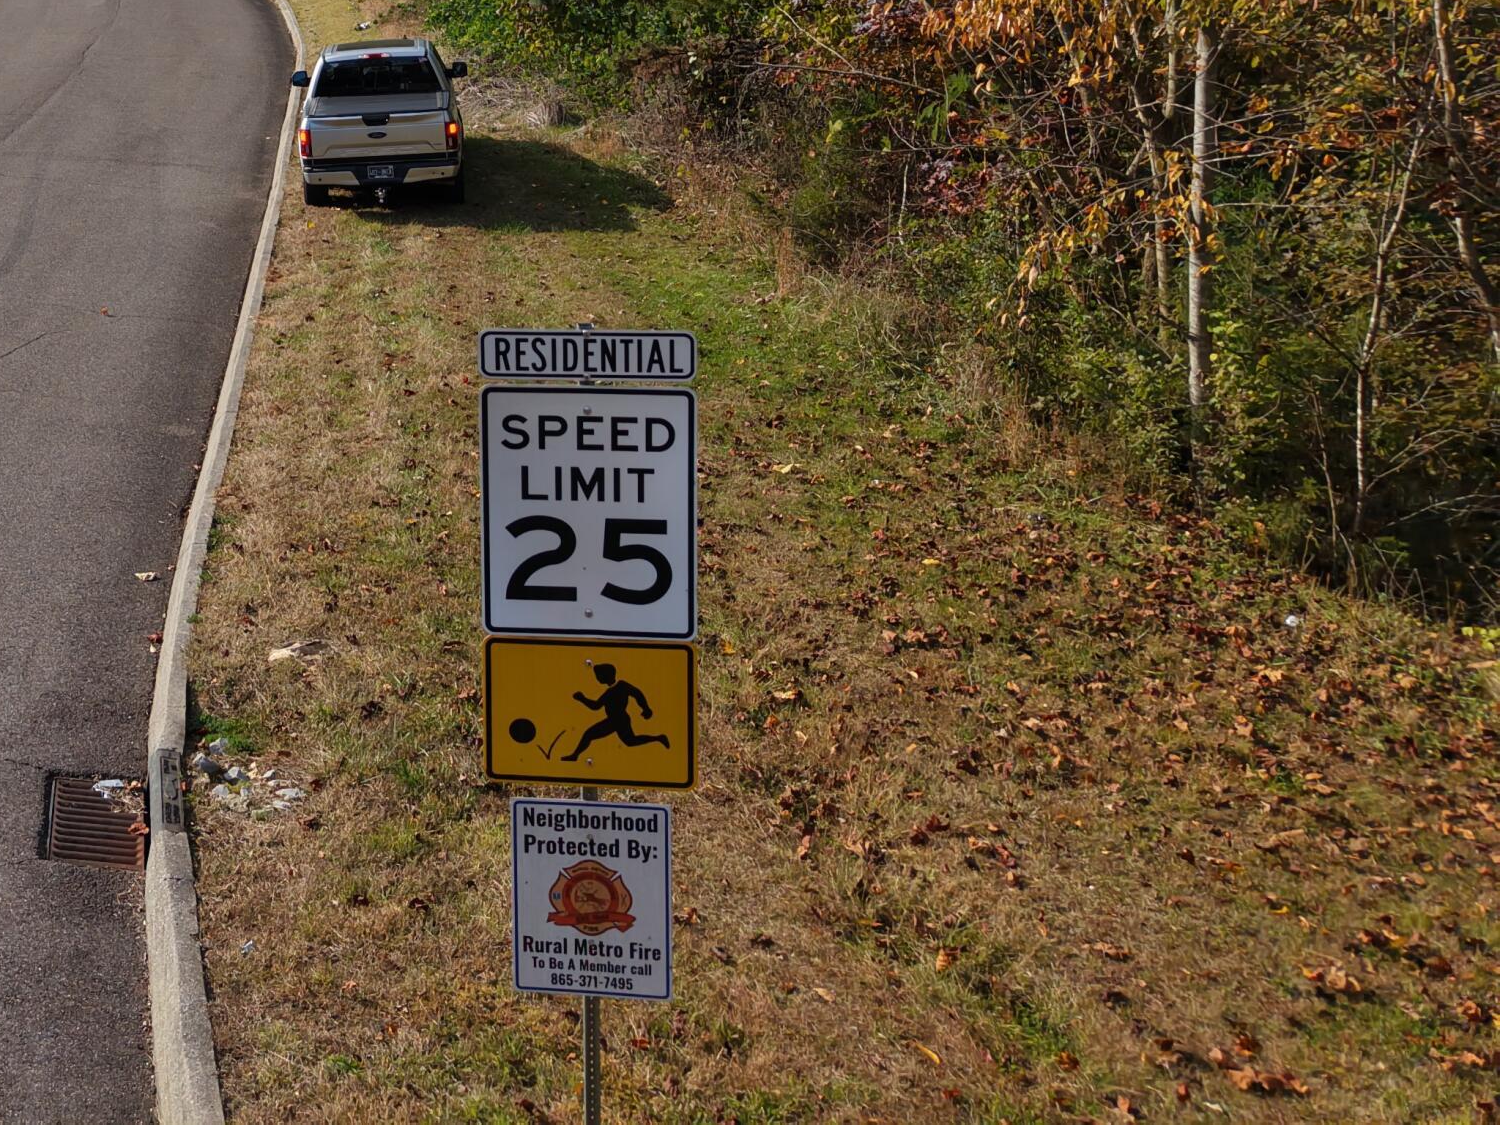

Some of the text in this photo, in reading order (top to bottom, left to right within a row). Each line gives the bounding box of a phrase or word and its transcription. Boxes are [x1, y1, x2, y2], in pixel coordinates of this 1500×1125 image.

[494, 337, 684, 373] RESIDENTIAL
[501, 414, 676, 452] SPEED
[521, 465, 655, 503] LIMIT
[505, 515, 673, 605] 25
[523, 807, 658, 833] Neighborhood
[524, 834, 658, 863] Protected By:
[523, 935, 662, 961] Rural Metro Fire
[532, 956, 652, 976] To Be A Member call
[551, 973, 634, 991] 865-371-7495
